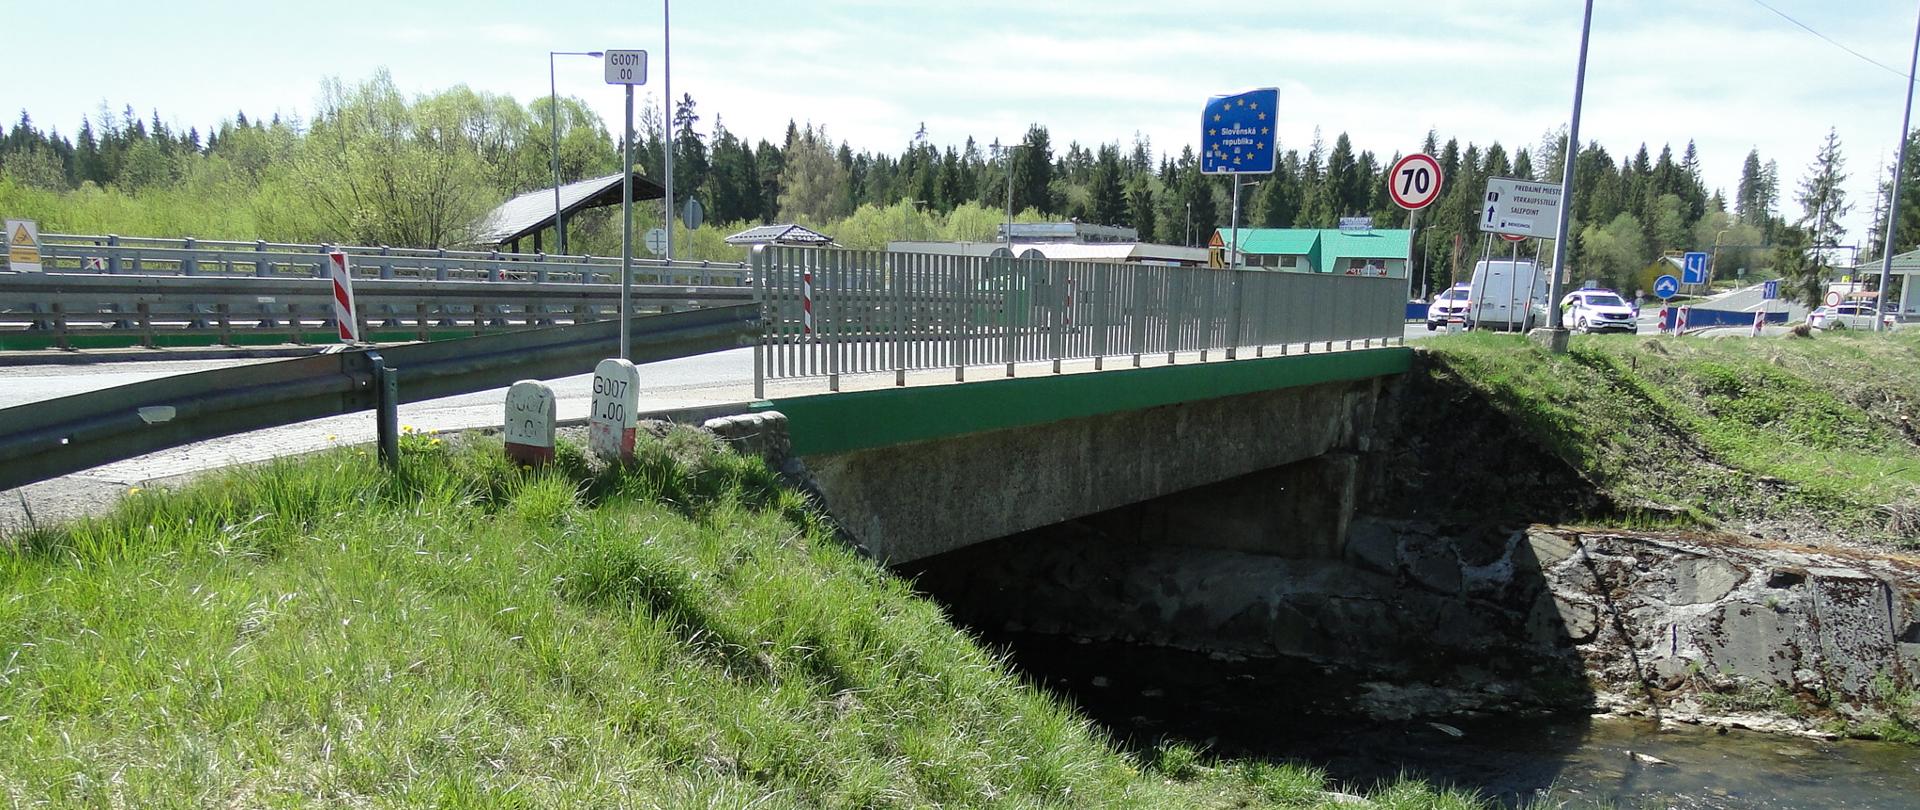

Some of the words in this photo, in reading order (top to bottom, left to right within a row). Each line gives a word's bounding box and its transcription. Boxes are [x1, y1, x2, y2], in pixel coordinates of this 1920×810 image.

[611, 54, 639, 65] G0071
[1221, 127, 1256, 135] Slovenská
[1222, 138, 1254, 146] republika
[1402, 168, 1429, 195] 70
[1513, 196, 1557, 206] VERKAUFSSTELLE
[1510, 207, 1539, 215] SALEPOINT
[593, 376, 627, 398] G007
